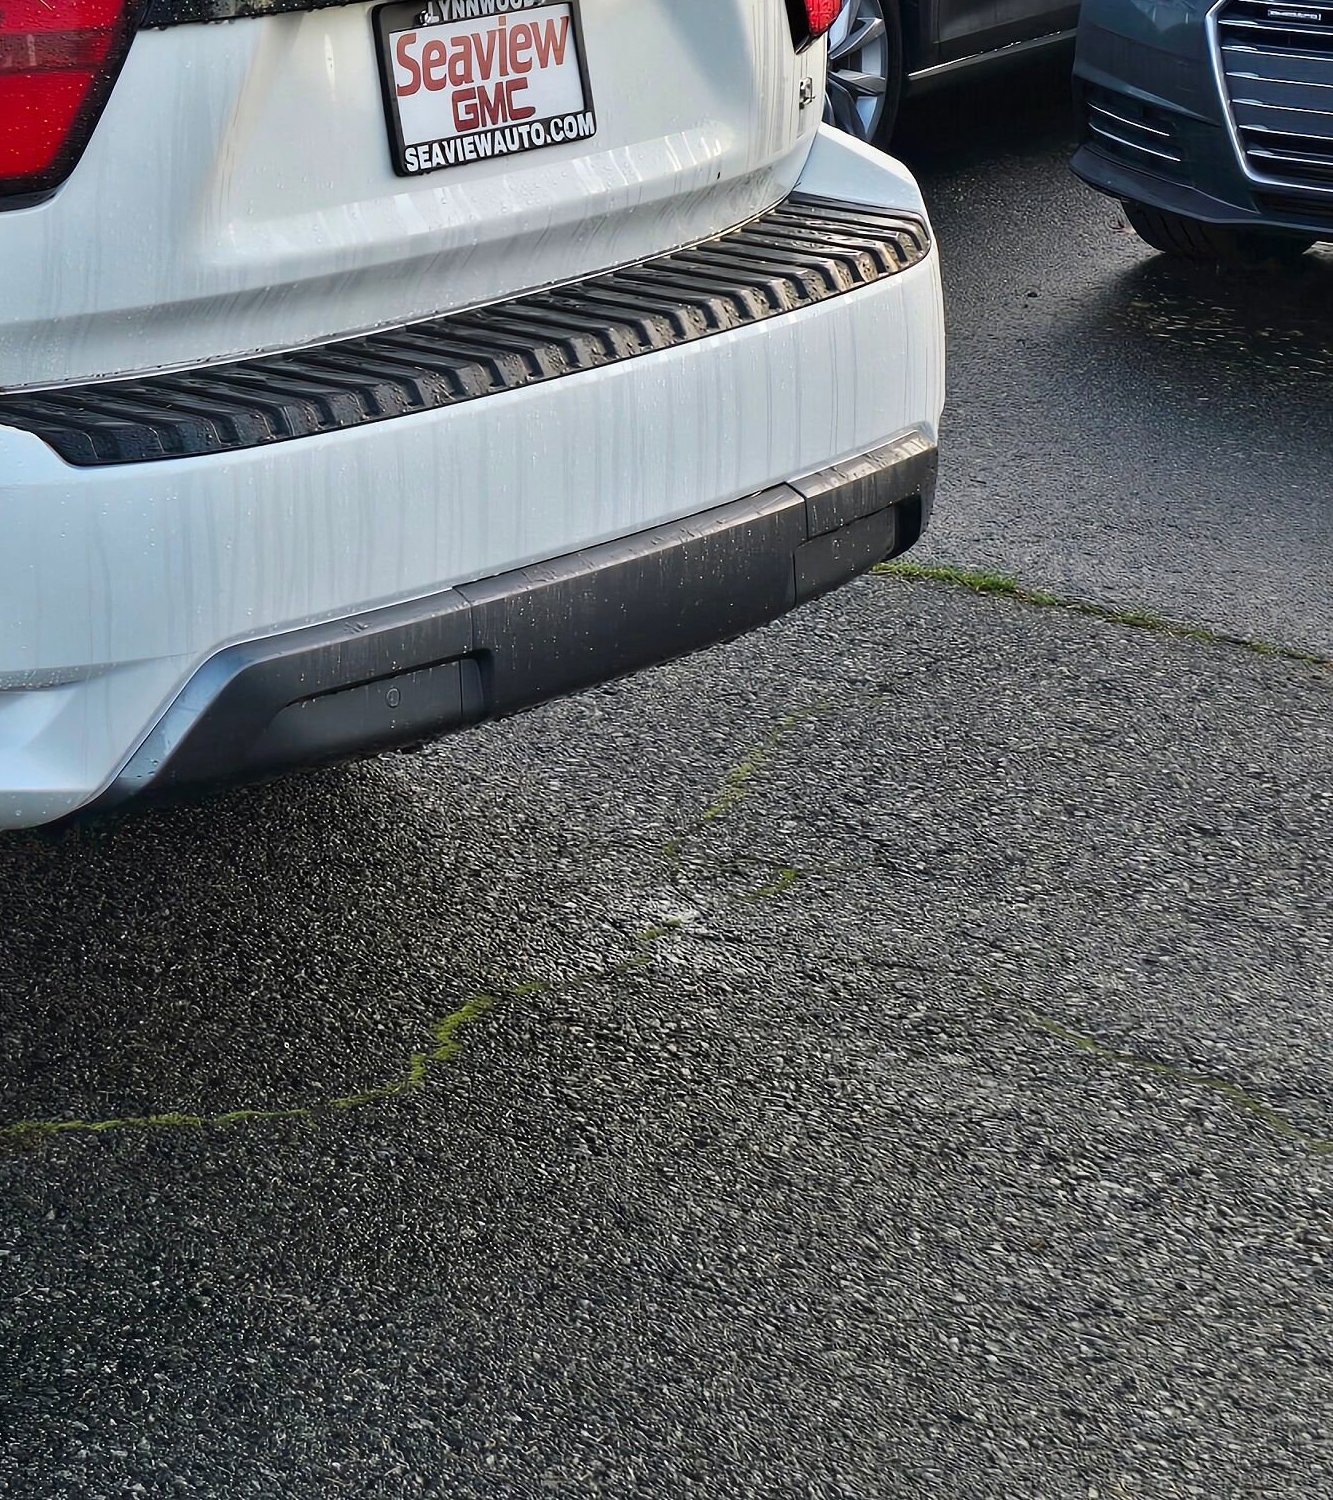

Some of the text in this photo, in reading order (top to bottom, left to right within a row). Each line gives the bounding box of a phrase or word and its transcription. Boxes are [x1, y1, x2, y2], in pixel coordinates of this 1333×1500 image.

[396, 15, 570, 96] Seaview
[451, 77, 536, 132] GMC
[405, 112, 596, 172] SEAVIEWAUTO.COM
